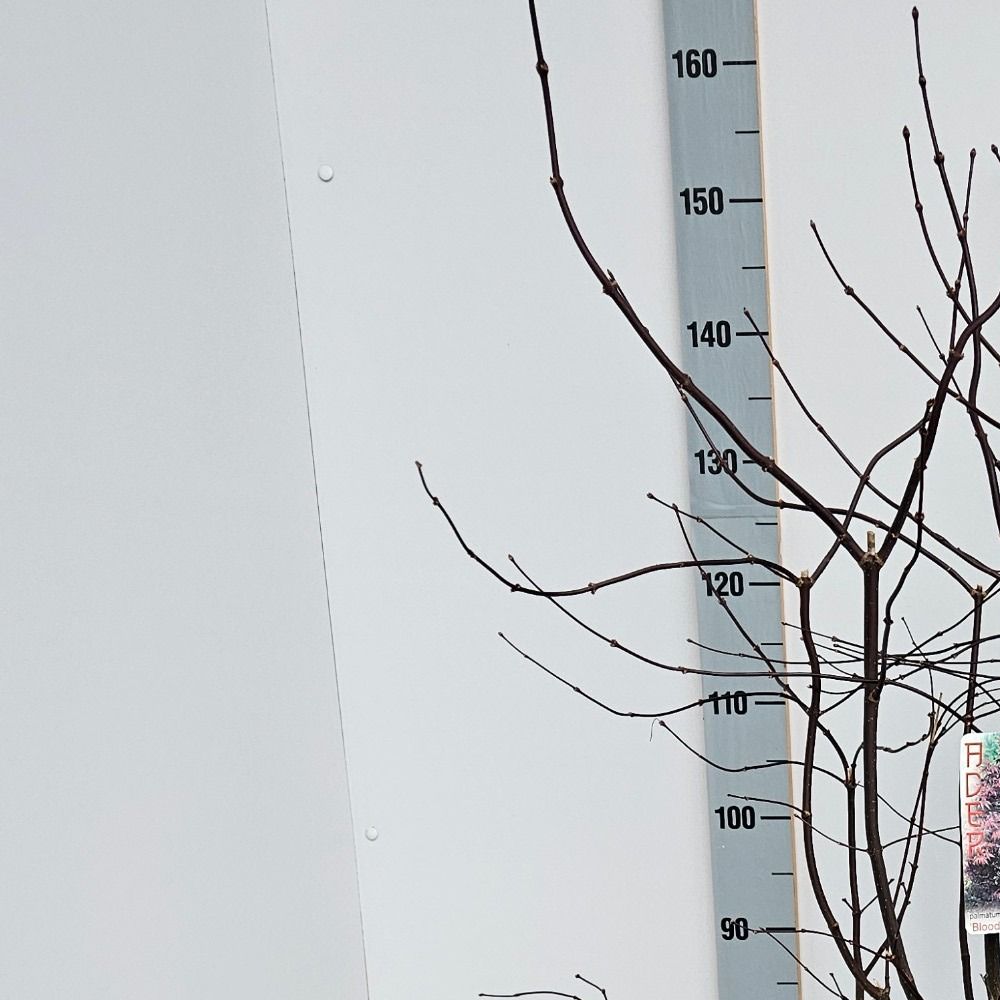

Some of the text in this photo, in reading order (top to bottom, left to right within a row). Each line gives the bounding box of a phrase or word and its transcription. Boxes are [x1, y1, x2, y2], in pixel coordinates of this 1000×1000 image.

[672, 49, 717, 78] 160
[680, 187, 723, 215] 150
[687, 321, 731, 347] 140
[694, 449, 737, 474] 130
[702, 571, 744, 597] 120
[709, 691, 748, 715] 110
[715, 806, 755, 829] 100
[721, 918, 748, 940] 90
